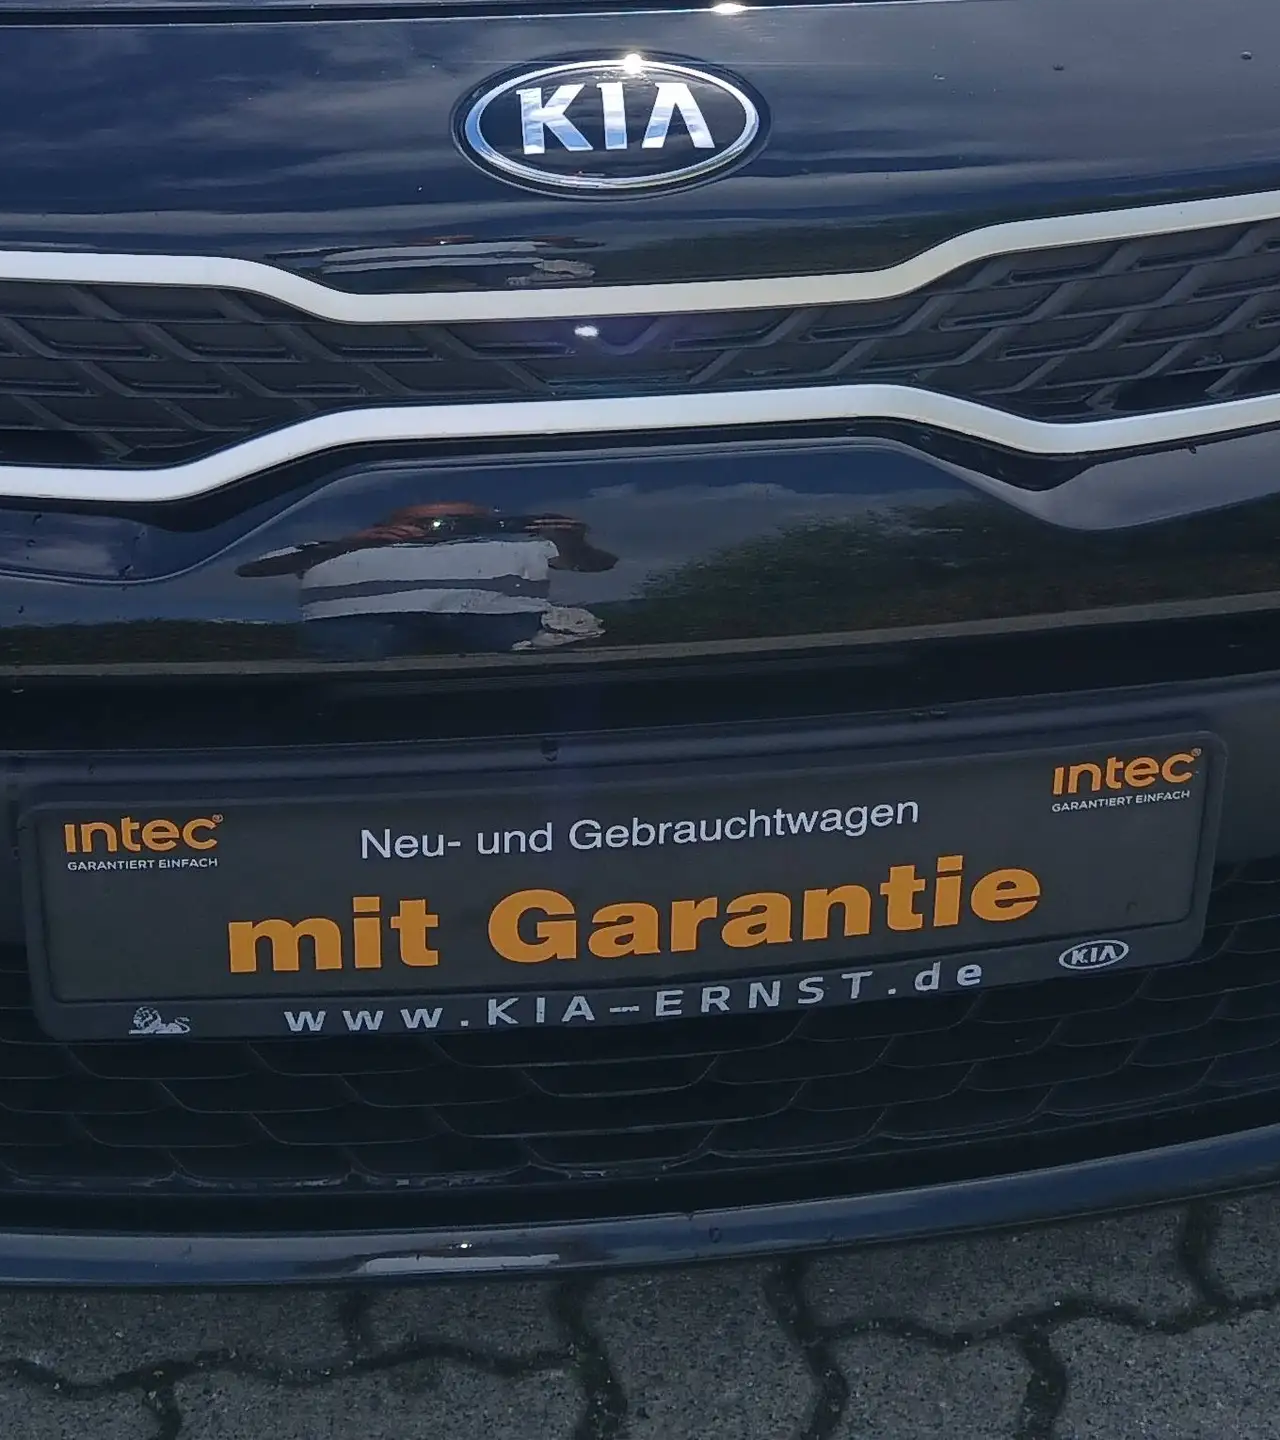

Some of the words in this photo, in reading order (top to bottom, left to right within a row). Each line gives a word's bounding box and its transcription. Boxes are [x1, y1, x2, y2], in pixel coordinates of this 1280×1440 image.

[516, 81, 716, 155] KIA
[1052, 747, 1202, 795] intec
[1051, 795, 1133, 812] GARANTIERT
[1135, 790, 1191, 804] EINFACH
[64, 816, 224, 853] intec
[361, 828, 461, 859] Neu-
[477, 822, 553, 854] und
[569, 800, 920, 850] Gebrauchtwagen
[67, 860, 155, 871] GARANTIERT
[158, 858, 218, 869] EINFACH
[228, 896, 439, 973] mit
[488, 854, 1041, 963] Garantie
